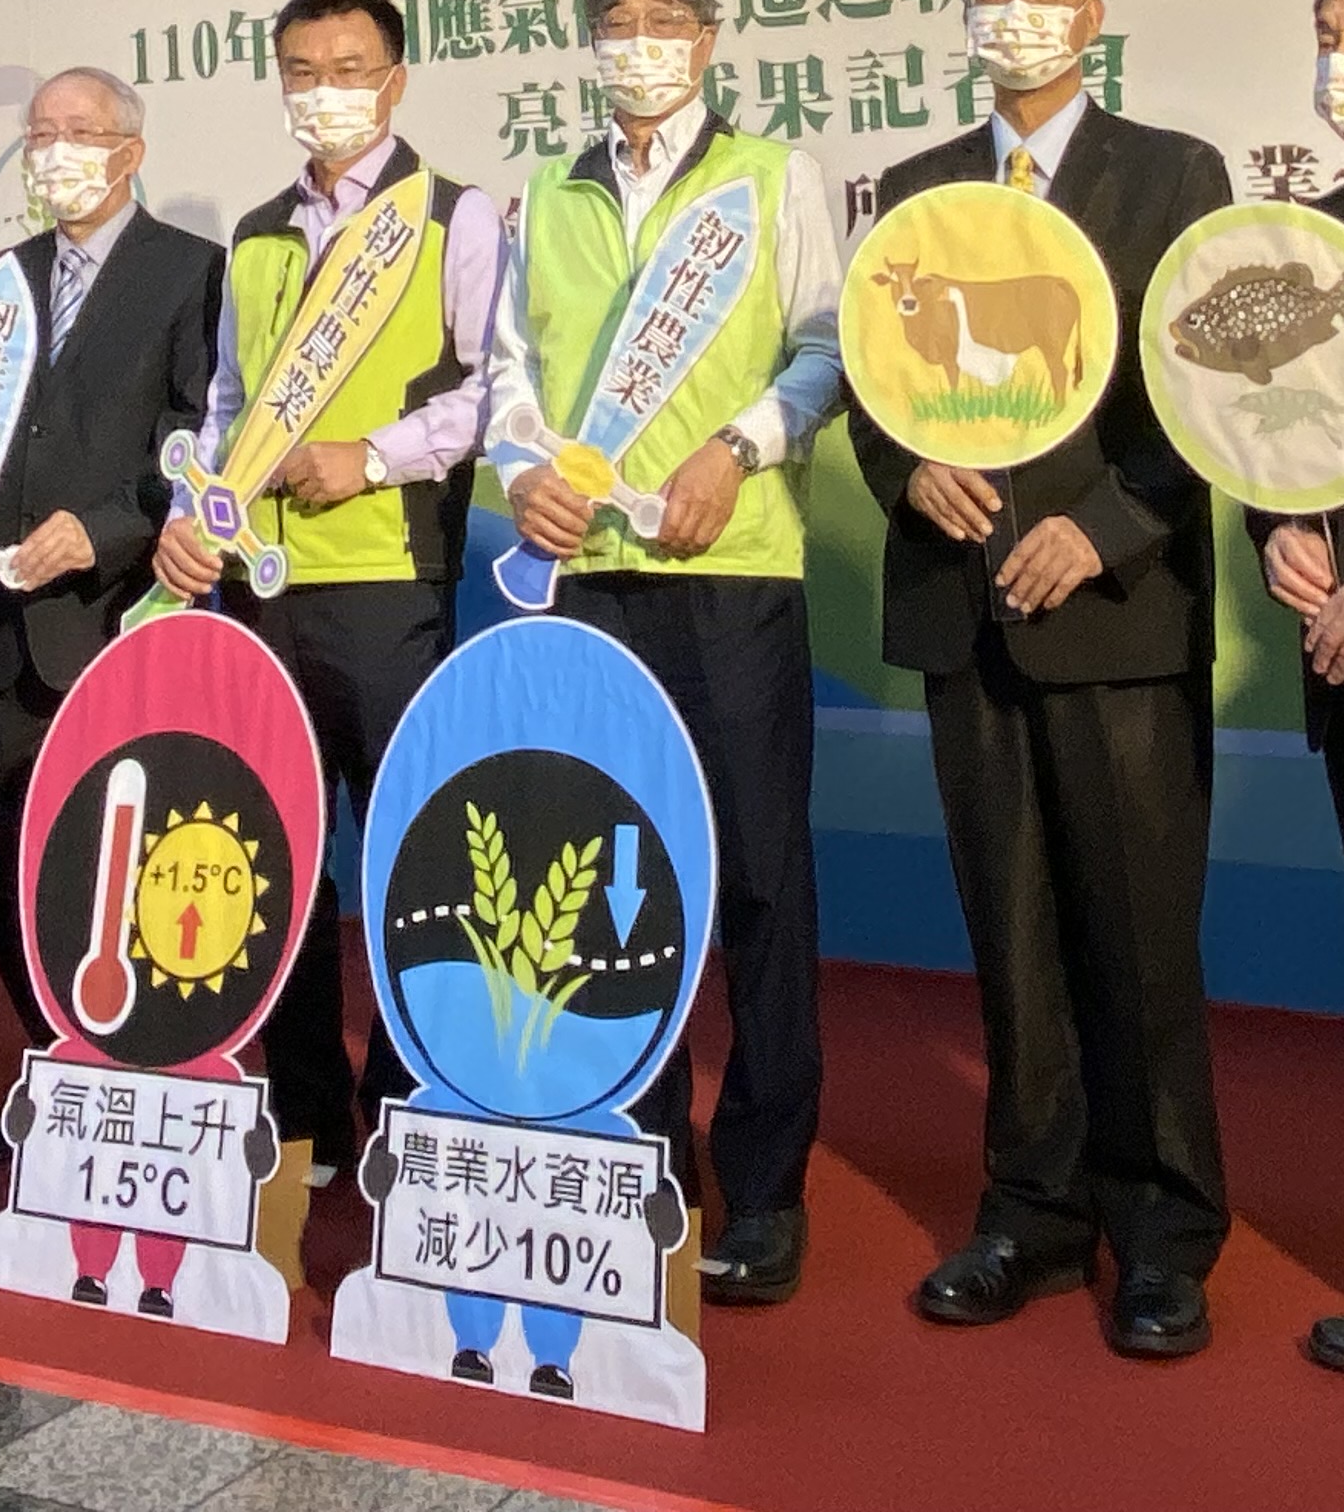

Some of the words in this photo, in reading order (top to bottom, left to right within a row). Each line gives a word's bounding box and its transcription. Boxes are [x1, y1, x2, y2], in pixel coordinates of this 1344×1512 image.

[264, 199, 416, 433] 韌性農業
[607, 209, 744, 416] 韌性農業
[45, 1079, 236, 1160] 氣溫上升
[399, 1133, 645, 1219] 農業水資源
[415, 1208, 622, 1296] 減少10%
